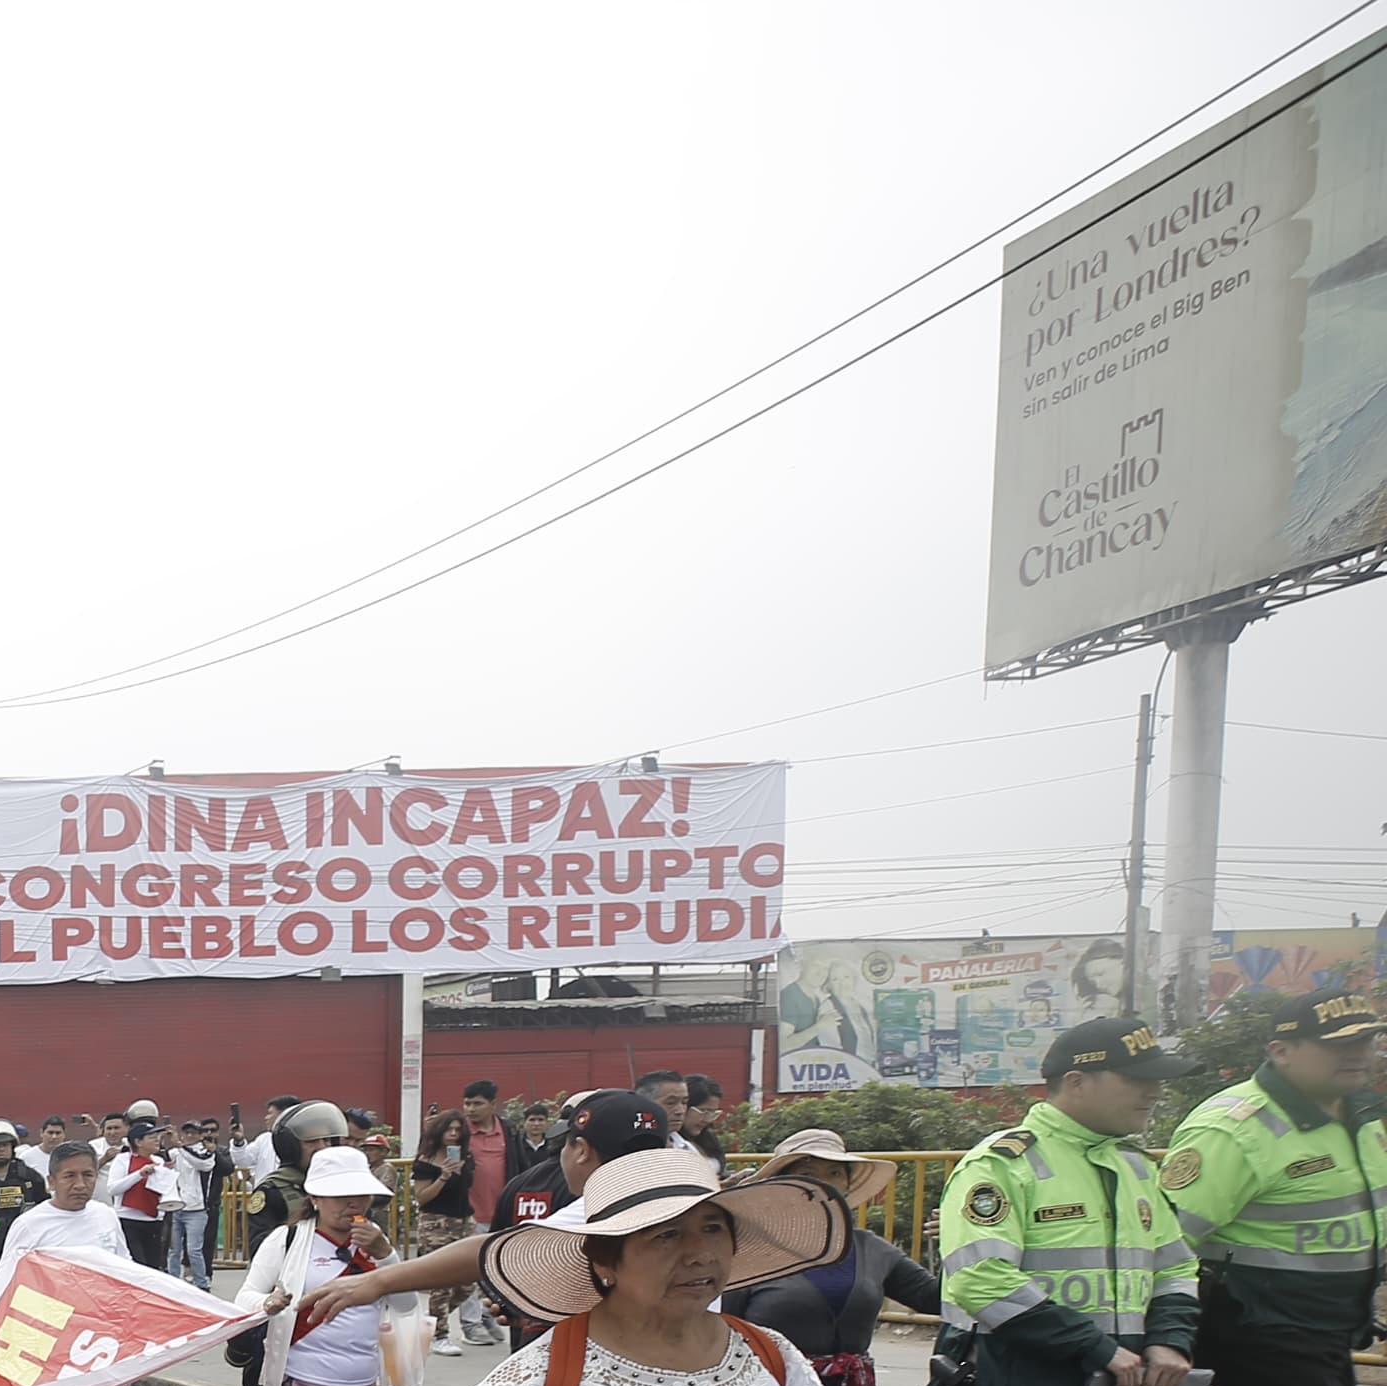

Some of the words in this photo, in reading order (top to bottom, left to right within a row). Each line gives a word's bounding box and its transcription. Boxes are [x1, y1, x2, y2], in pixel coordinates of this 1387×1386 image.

[1028, 247, 1108, 317] ¿Una
[1126, 180, 1234, 256] vuelta
[1026, 308, 1081, 366] por
[1094, 205, 1261, 325] Londres?
[1024, 366, 1057, 392] Ven
[1061, 357, 1073, 380] y
[1077, 327, 1145, 363] conoce
[1150, 307, 1169, 333] el
[1173, 292, 1205, 322] Big
[1210, 269, 1251, 299] Ben
[1023, 396, 1047, 419] sin
[1052, 372, 1090, 406] salir
[1094, 358, 1117, 382] de
[1122, 336, 1170, 373] Lima
[1038, 452, 1159, 528] Castillo
[1065, 465, 1081, 488] El
[1018, 501, 1178, 588] Chancay
[1082, 507, 1108, 532] de
[59, 792, 290, 856] ¡DINA
[305, 776, 692, 848] INCAPAZ!
[388, 842, 784, 902] CORRUPTO
[52, 911, 334, 961] PUEBLO
[351, 906, 490, 954] LOS
[507, 897, 781, 951] REPUDI
[789, 1062, 851, 1083] VIDA
[792, 1082, 806, 1090] en
[1072, 1051, 1107, 1065] PERU
[517, 1197, 547, 1220] irtp
